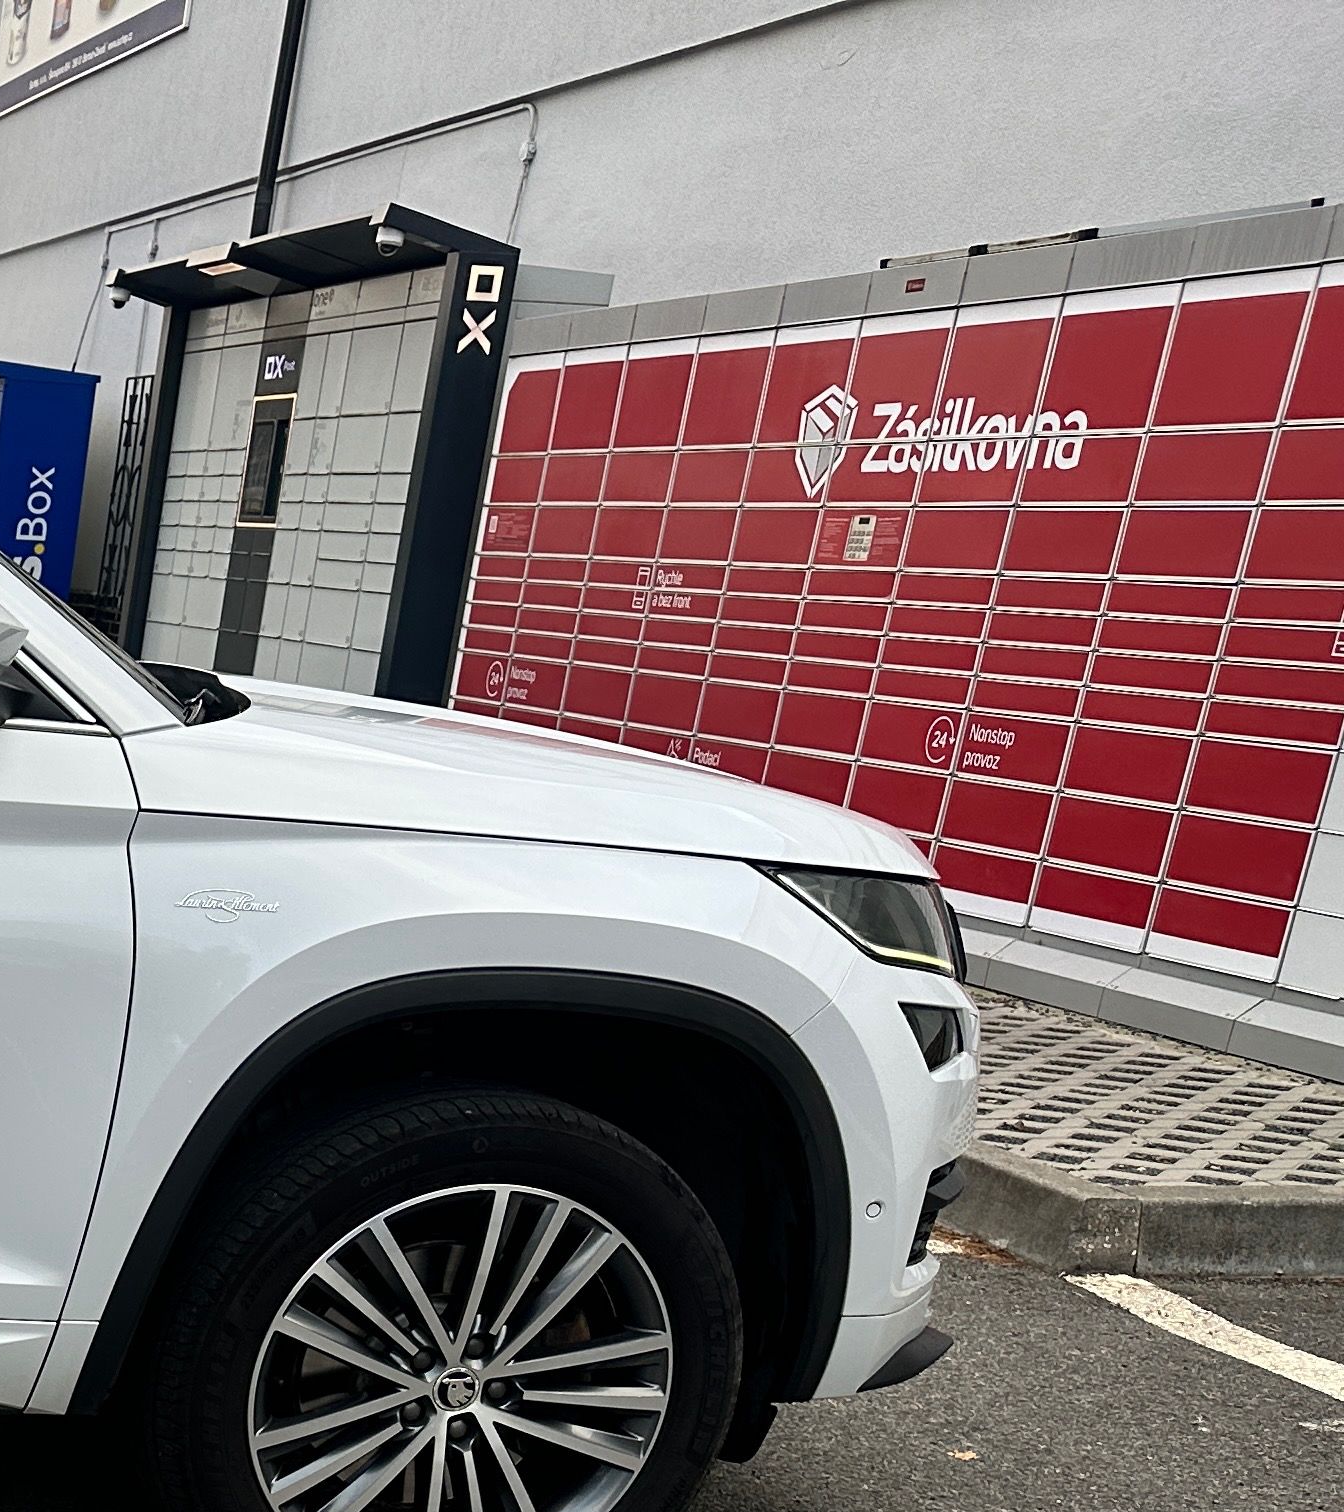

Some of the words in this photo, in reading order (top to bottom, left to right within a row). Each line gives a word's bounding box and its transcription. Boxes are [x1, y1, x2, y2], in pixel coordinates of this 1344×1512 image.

[860, 396, 1089, 474] Zásilkovna
[658, 592, 673, 608] bez
[489, 671, 500, 686] 24
[510, 665, 537, 684] Nonstop
[506, 686, 529, 700] provoz
[931, 730, 948, 748] 24
[968, 723, 1016, 750] Nonstop
[962, 751, 1001, 770] provoz
[359, 1153, 422, 1188] OUTSIDE
